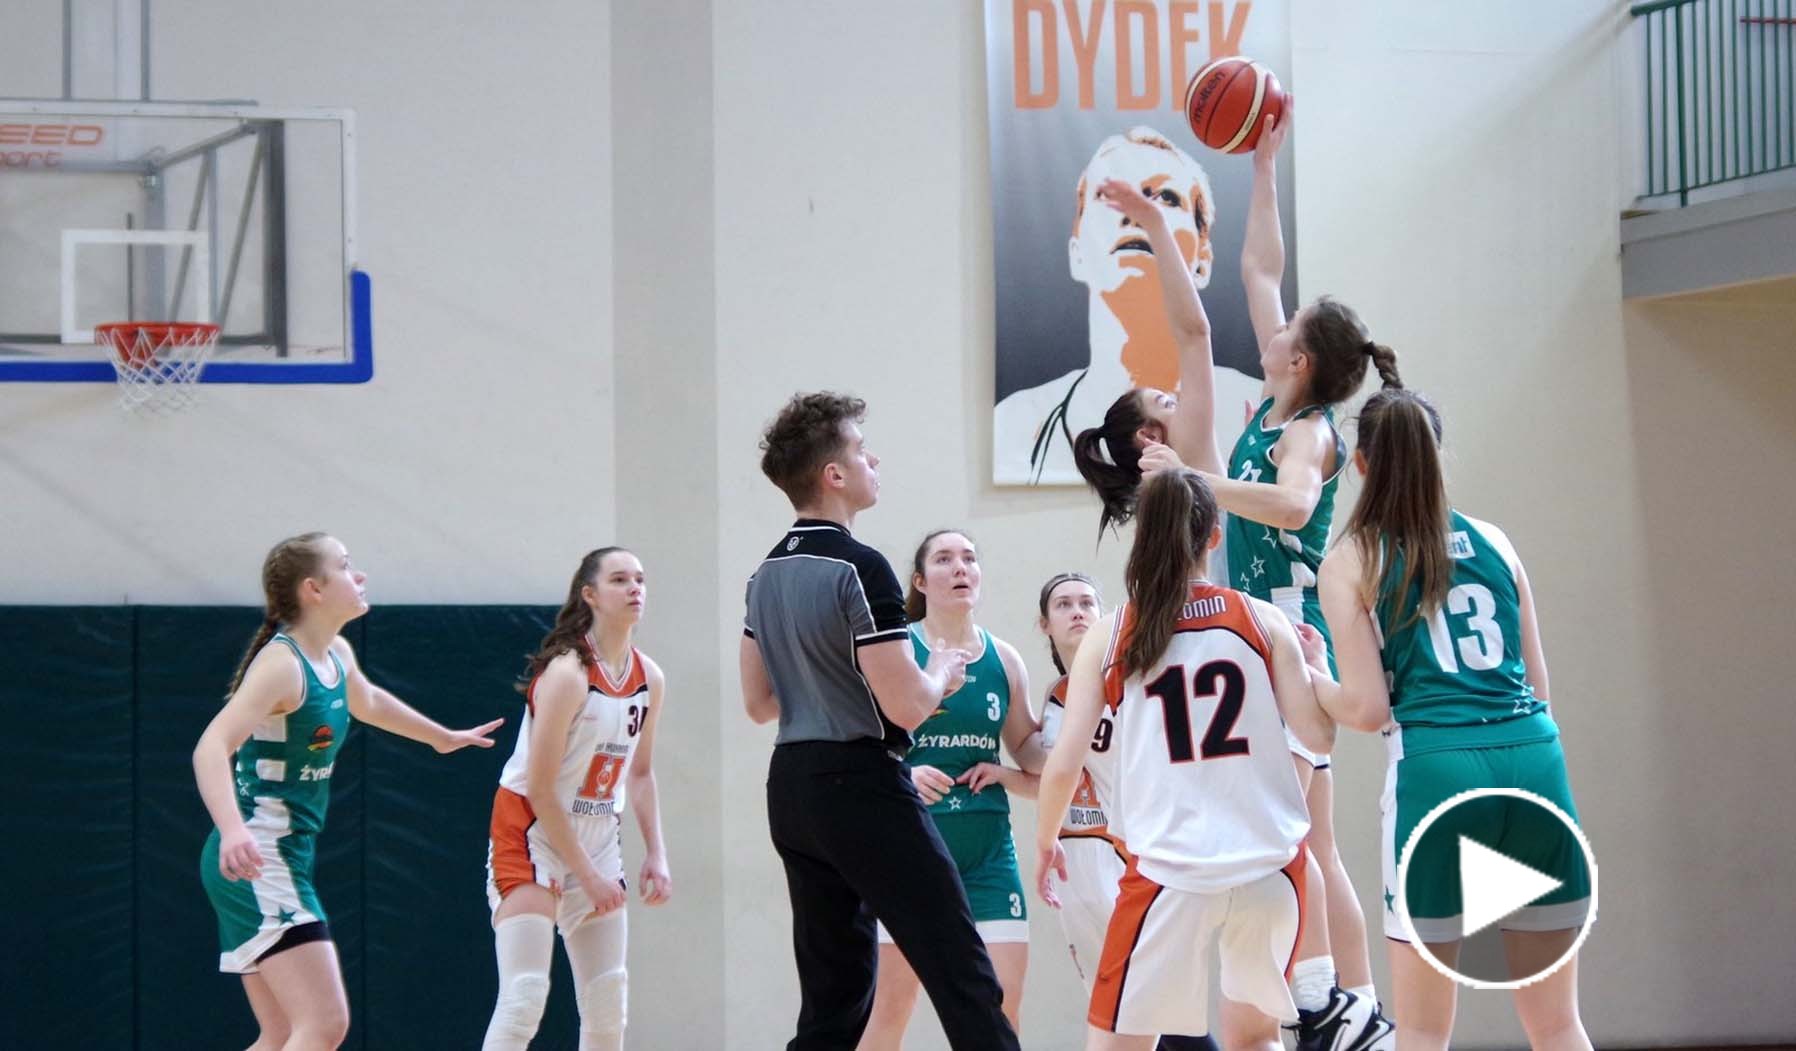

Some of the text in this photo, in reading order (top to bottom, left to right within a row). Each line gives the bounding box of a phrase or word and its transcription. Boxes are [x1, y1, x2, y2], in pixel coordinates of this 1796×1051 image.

[1194, 71, 1225, 124] molten
[1178, 595, 1227, 621] OMIN
[1416, 583, 1505, 673] 13
[986, 692, 1001, 722] 3
[1144, 658, 1251, 764] 12
[1009, 893, 1023, 918] 3
